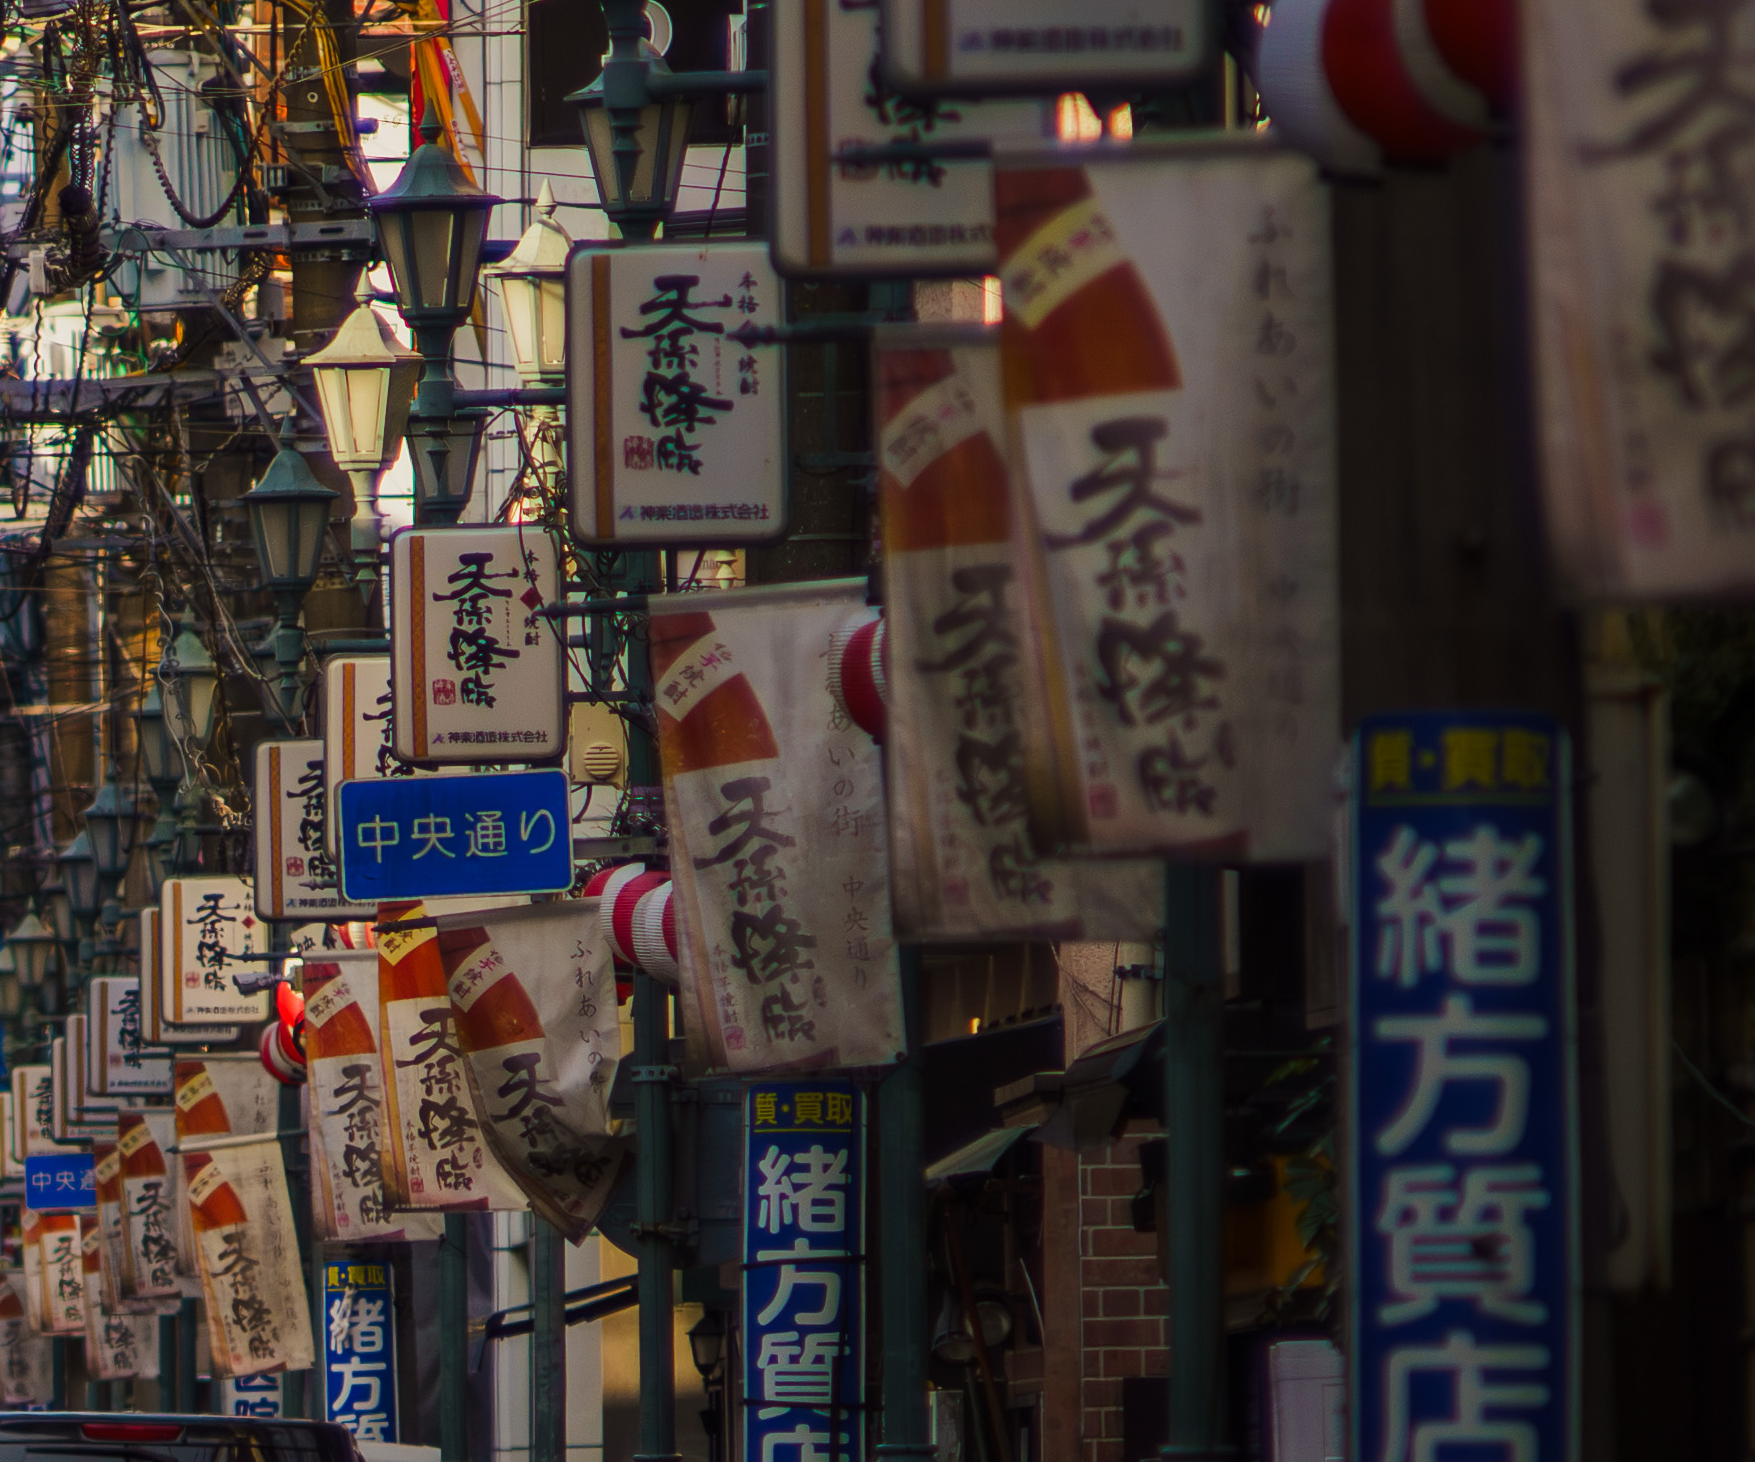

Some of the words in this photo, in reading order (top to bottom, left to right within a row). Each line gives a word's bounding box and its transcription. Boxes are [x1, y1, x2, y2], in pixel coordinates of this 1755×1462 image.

[738, 271, 760, 315] 本格
[619, 274, 735, 476] 天孫降臨
[433, 551, 521, 709] 天孫降臨
[1041, 415, 1230, 819] 天孫降臨
[448, 730, 549, 745] 神楽酒造株式会社
[357, 809, 556, 865] 中央通り
[186, 893, 241, 992] 天孫降臨
[694, 775, 818, 1045] 天孫降臨
[842, 879, 870, 990] 中央通り
[395, 1007, 478, 1193] 天孫降臨
[755, 1091, 854, 1127] 質・買取
